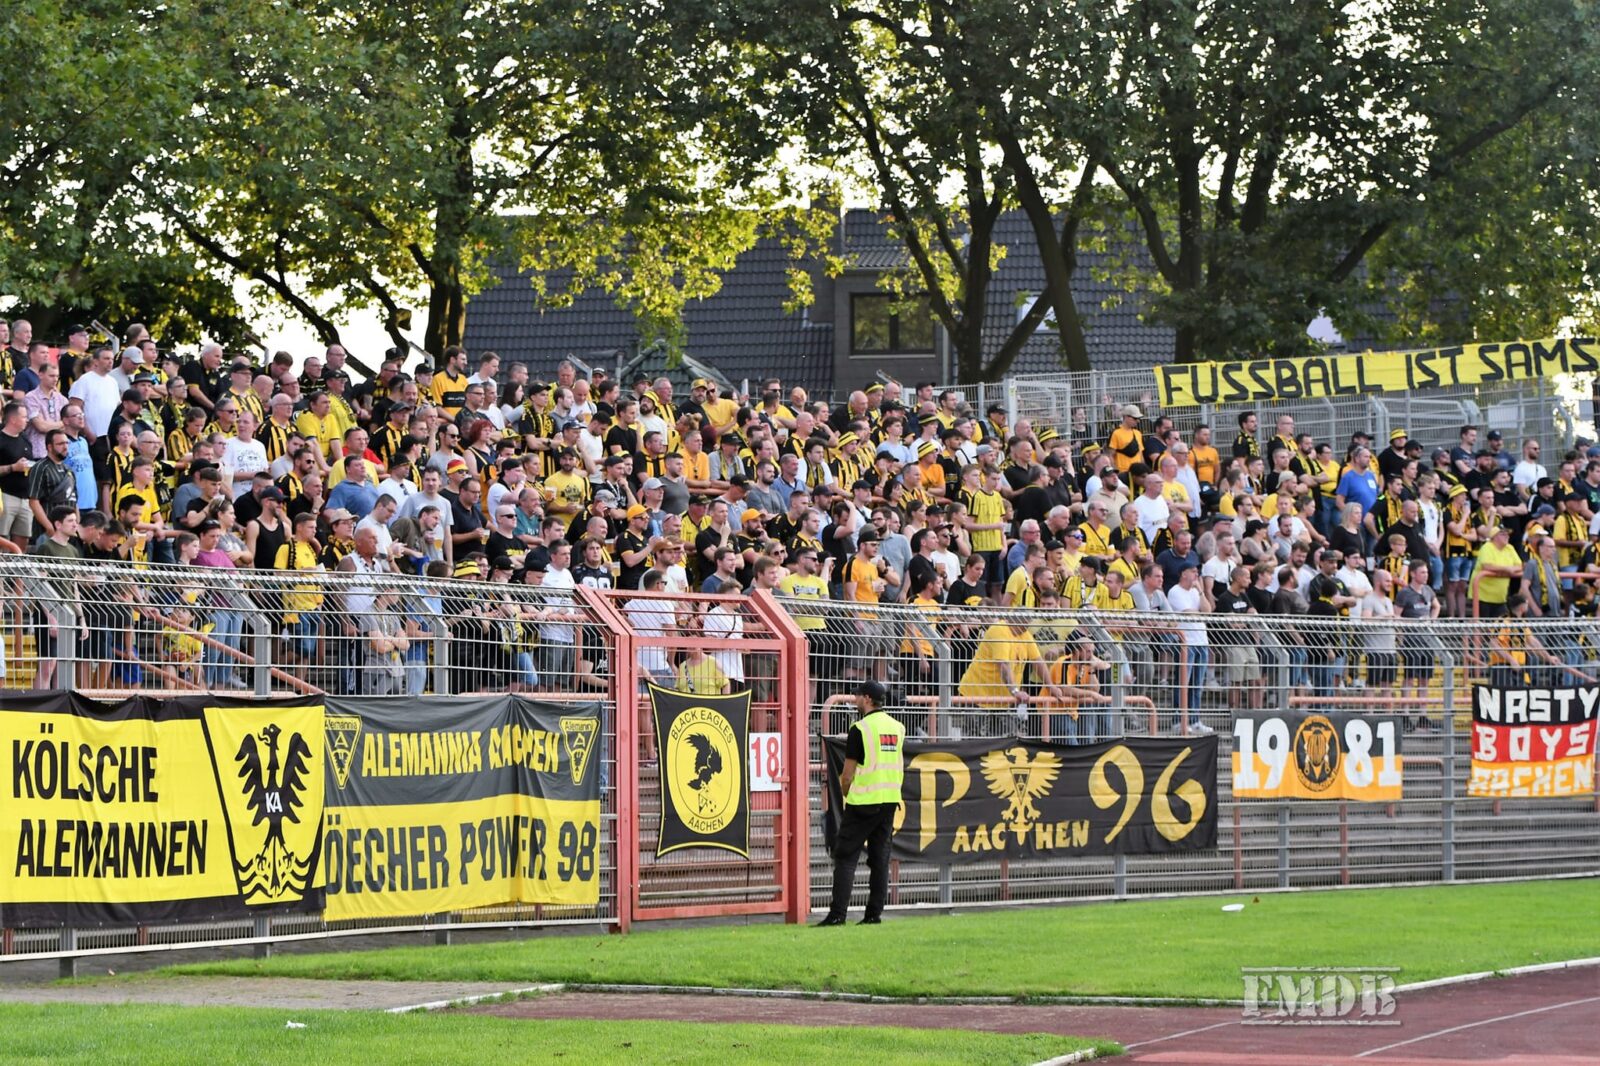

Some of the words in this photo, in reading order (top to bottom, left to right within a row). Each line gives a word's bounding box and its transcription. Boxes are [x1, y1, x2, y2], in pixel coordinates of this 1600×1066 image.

[1163, 356, 1383, 405] FUSSBALL
[1406, 346, 1463, 389] IST
[1478, 338, 1599, 382] SAMS
[1479, 686, 1599, 723] NASTY
[671, 711, 698, 741] BLACK
[700, 711, 734, 744] EAGLES
[1474, 723, 1590, 761] BOYS
[12, 723, 159, 803] KÖLSCHE
[362, 731, 482, 777] ALEMANNIA
[751, 736, 780, 779] 18
[266, 791, 282, 813] KA
[1088, 745, 1206, 844] 96
[688, 816, 724, 832] AACHEN
[15, 819, 208, 879] ALEMANNEN
[324, 814, 449, 895] ÖECHER
[459, 814, 547, 885] POWER
[557, 820, 597, 882] 98
